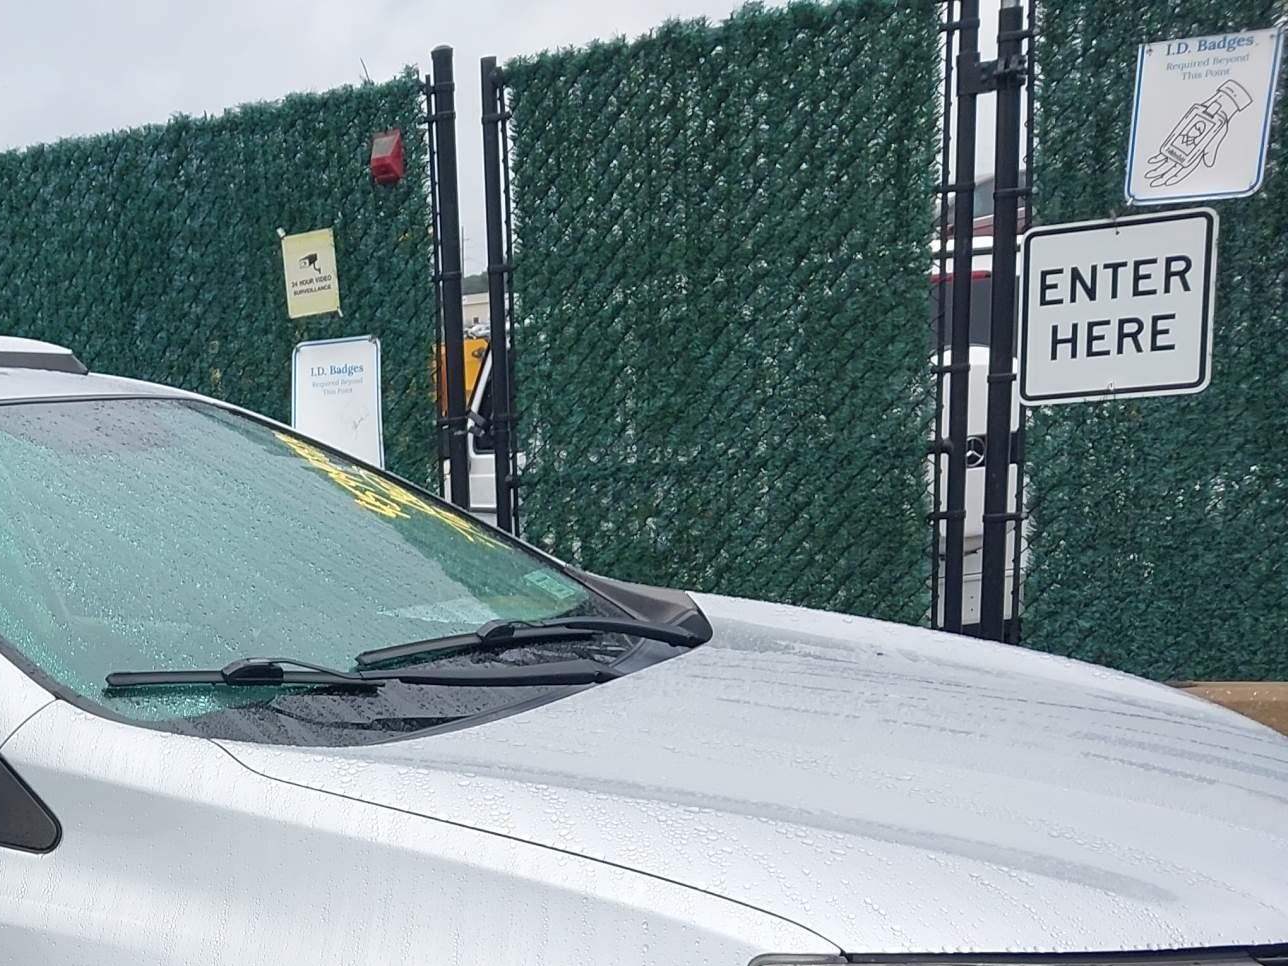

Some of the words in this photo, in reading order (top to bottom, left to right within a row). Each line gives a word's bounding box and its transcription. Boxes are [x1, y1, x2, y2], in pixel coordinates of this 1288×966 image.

[1166, 42, 1192, 57] I.D.
[1197, 35, 1256, 53] Badges
[1166, 58, 1210, 71] Required
[1182, 70, 1203, 80] This
[1205, 68, 1231, 78] Point
[1039, 254, 1193, 307] ENTER
[1050, 312, 1176, 361] HERE
[311, 366, 327, 377] I.D.
[329, 363, 364, 377] Badges
